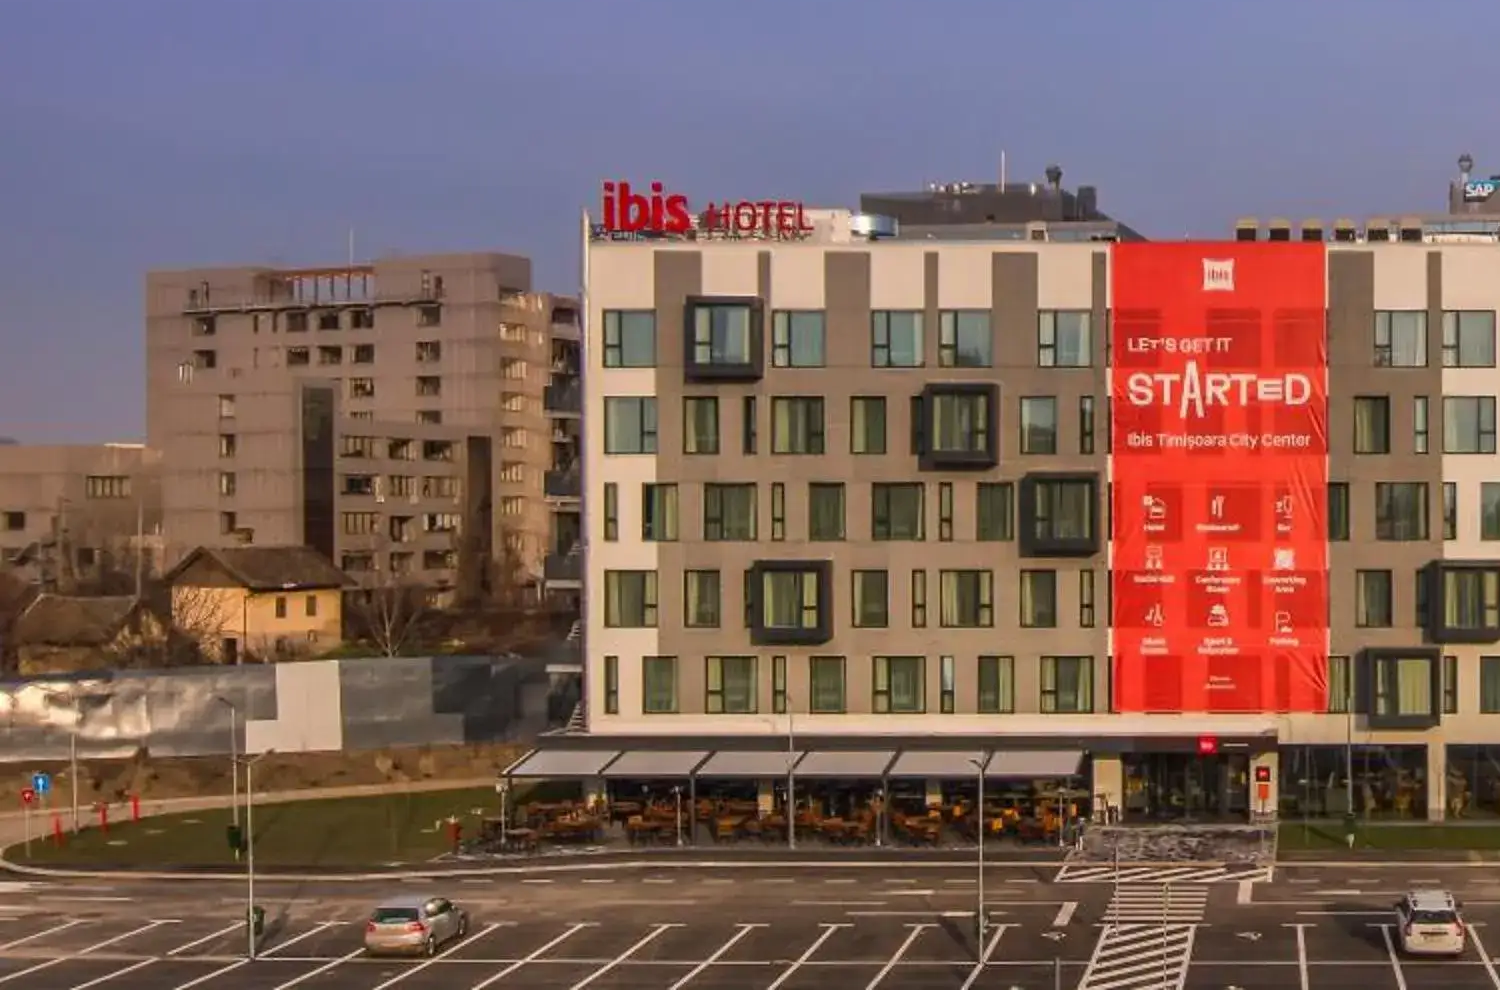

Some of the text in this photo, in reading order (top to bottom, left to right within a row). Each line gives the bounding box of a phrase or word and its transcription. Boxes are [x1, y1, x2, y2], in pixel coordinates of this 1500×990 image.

[1465, 183, 1494, 198] SAP
[604, 181, 815, 233] ibis HOTEL
[1127, 337, 1233, 353] LET'S GET IT
[1127, 360, 1312, 419] STARTED
[1229, 433, 1259, 450] City
[1261, 433, 1312, 447] Center
